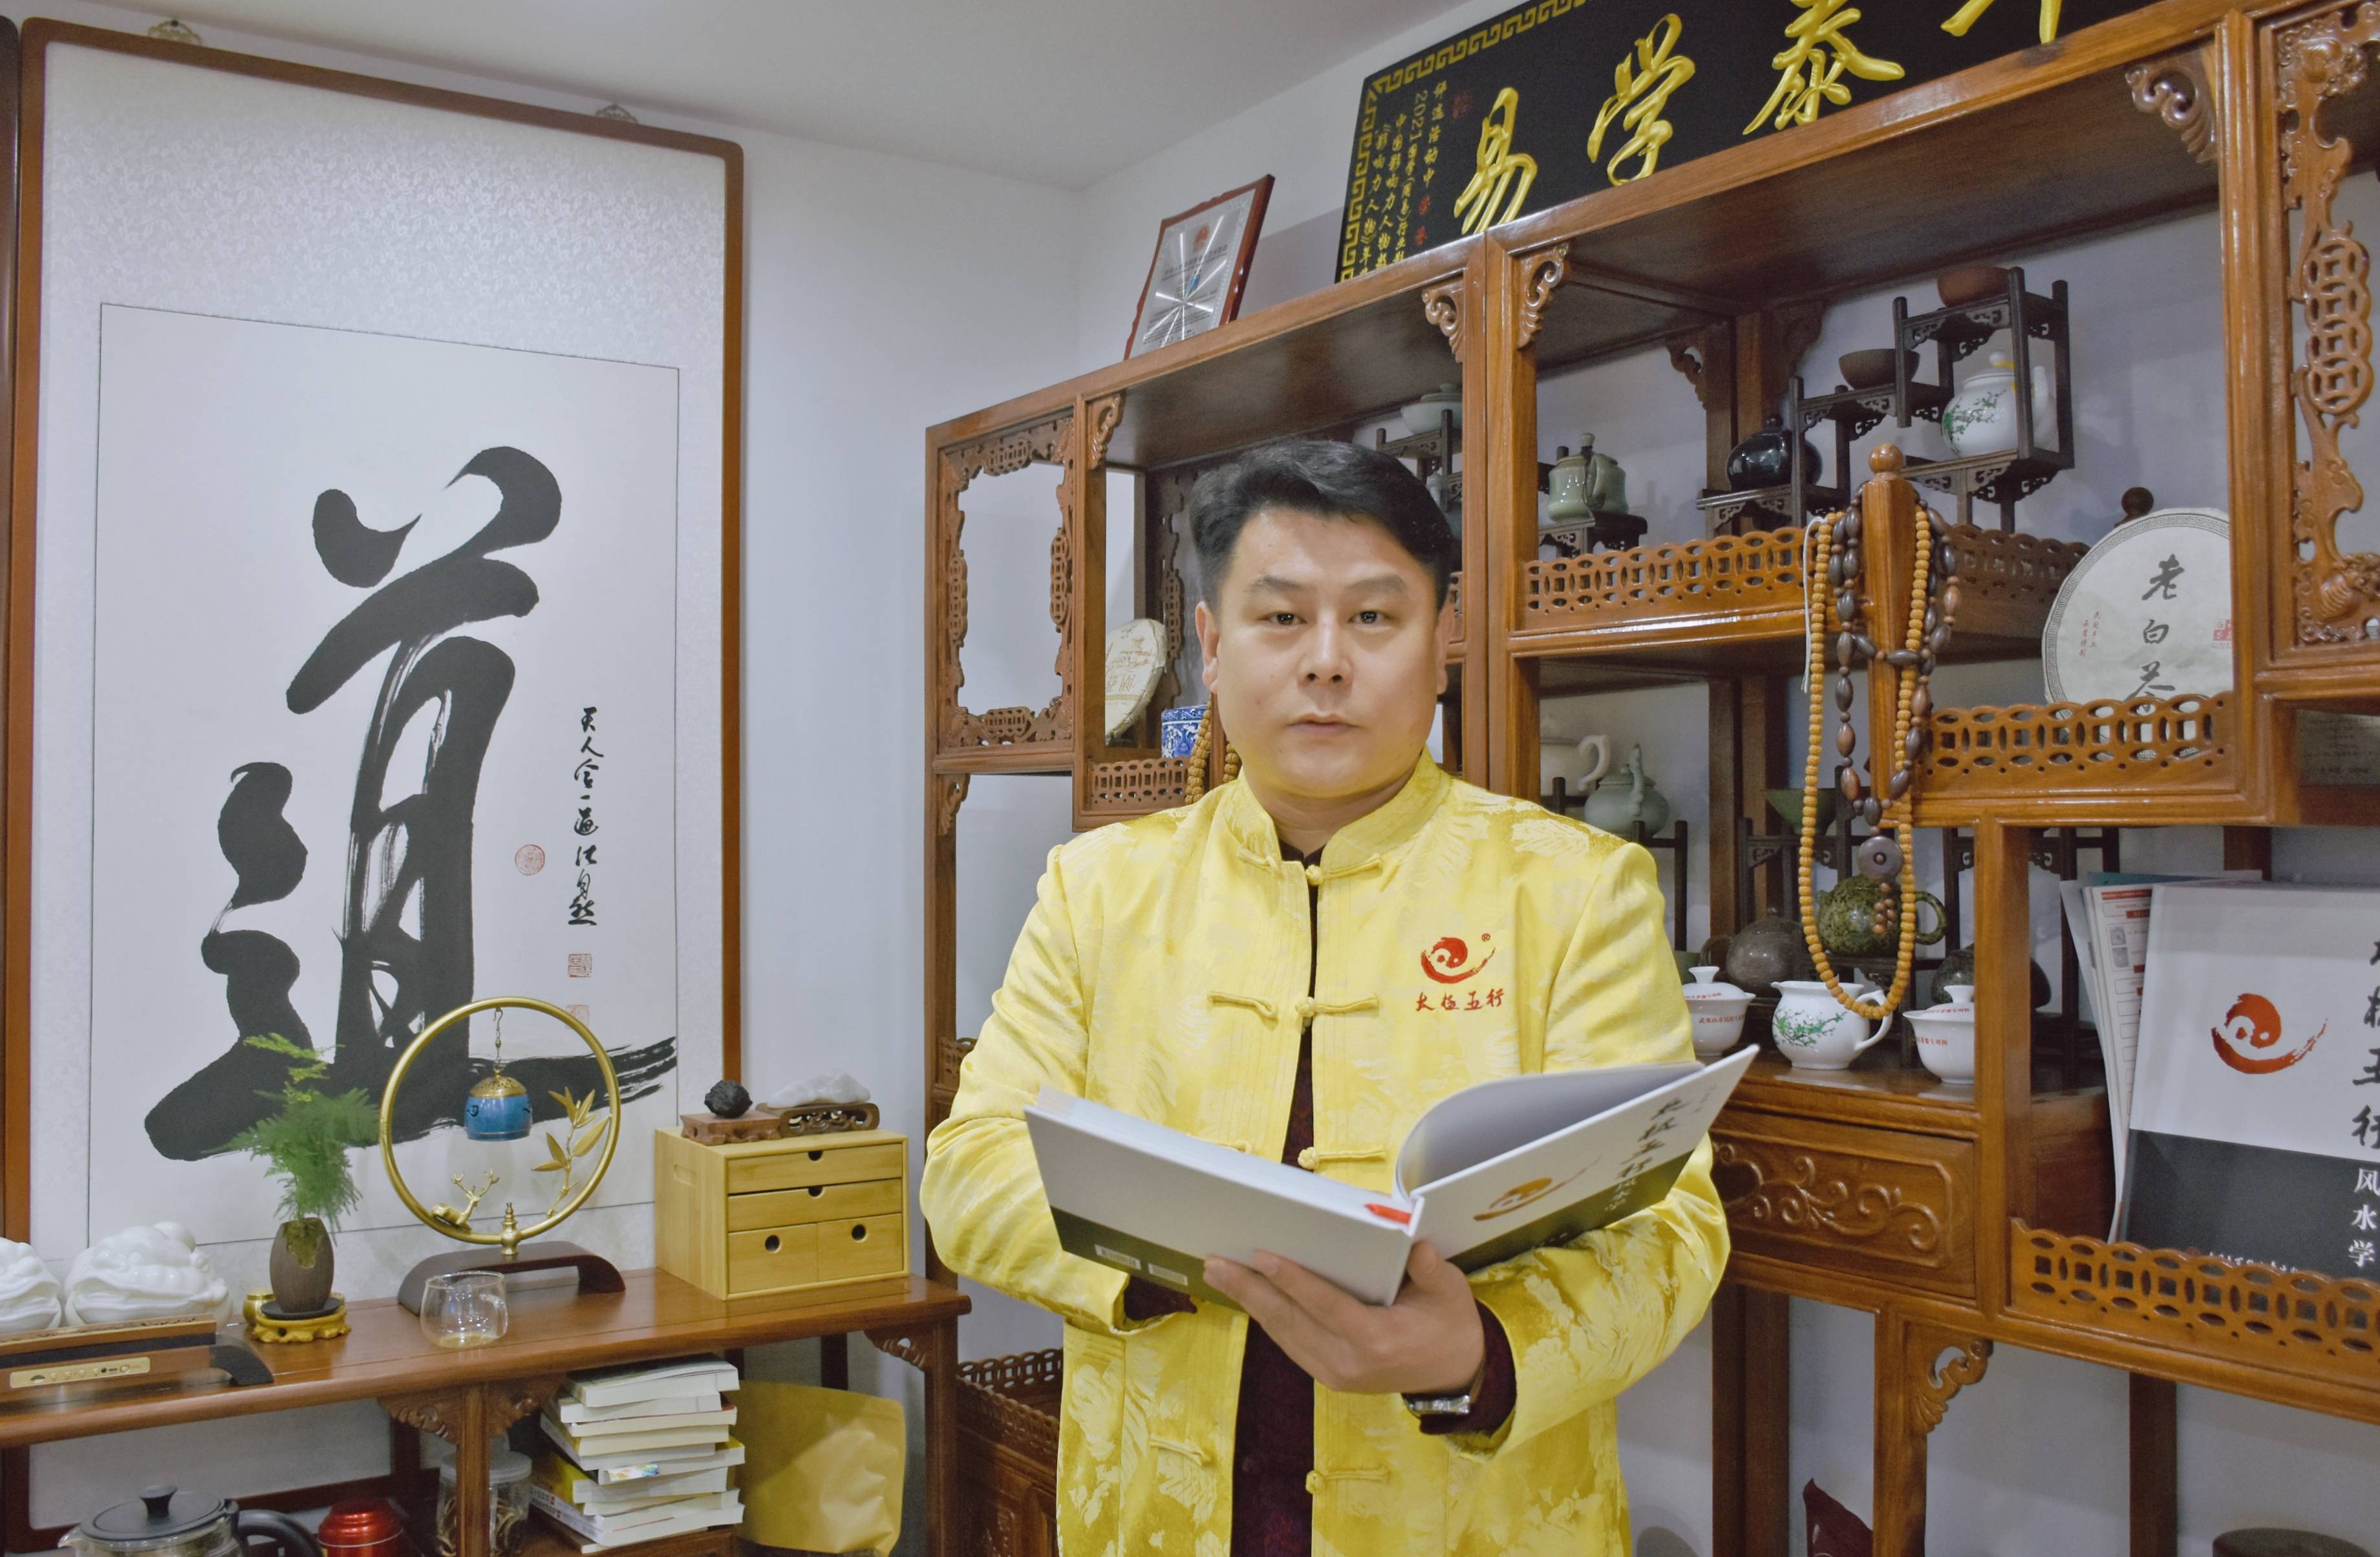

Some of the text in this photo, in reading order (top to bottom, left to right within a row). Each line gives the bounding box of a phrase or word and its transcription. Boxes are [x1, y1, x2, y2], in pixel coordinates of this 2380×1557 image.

[145, 446, 677, 1162] 道
[2348, 1168, 2380, 1267] 风水学
